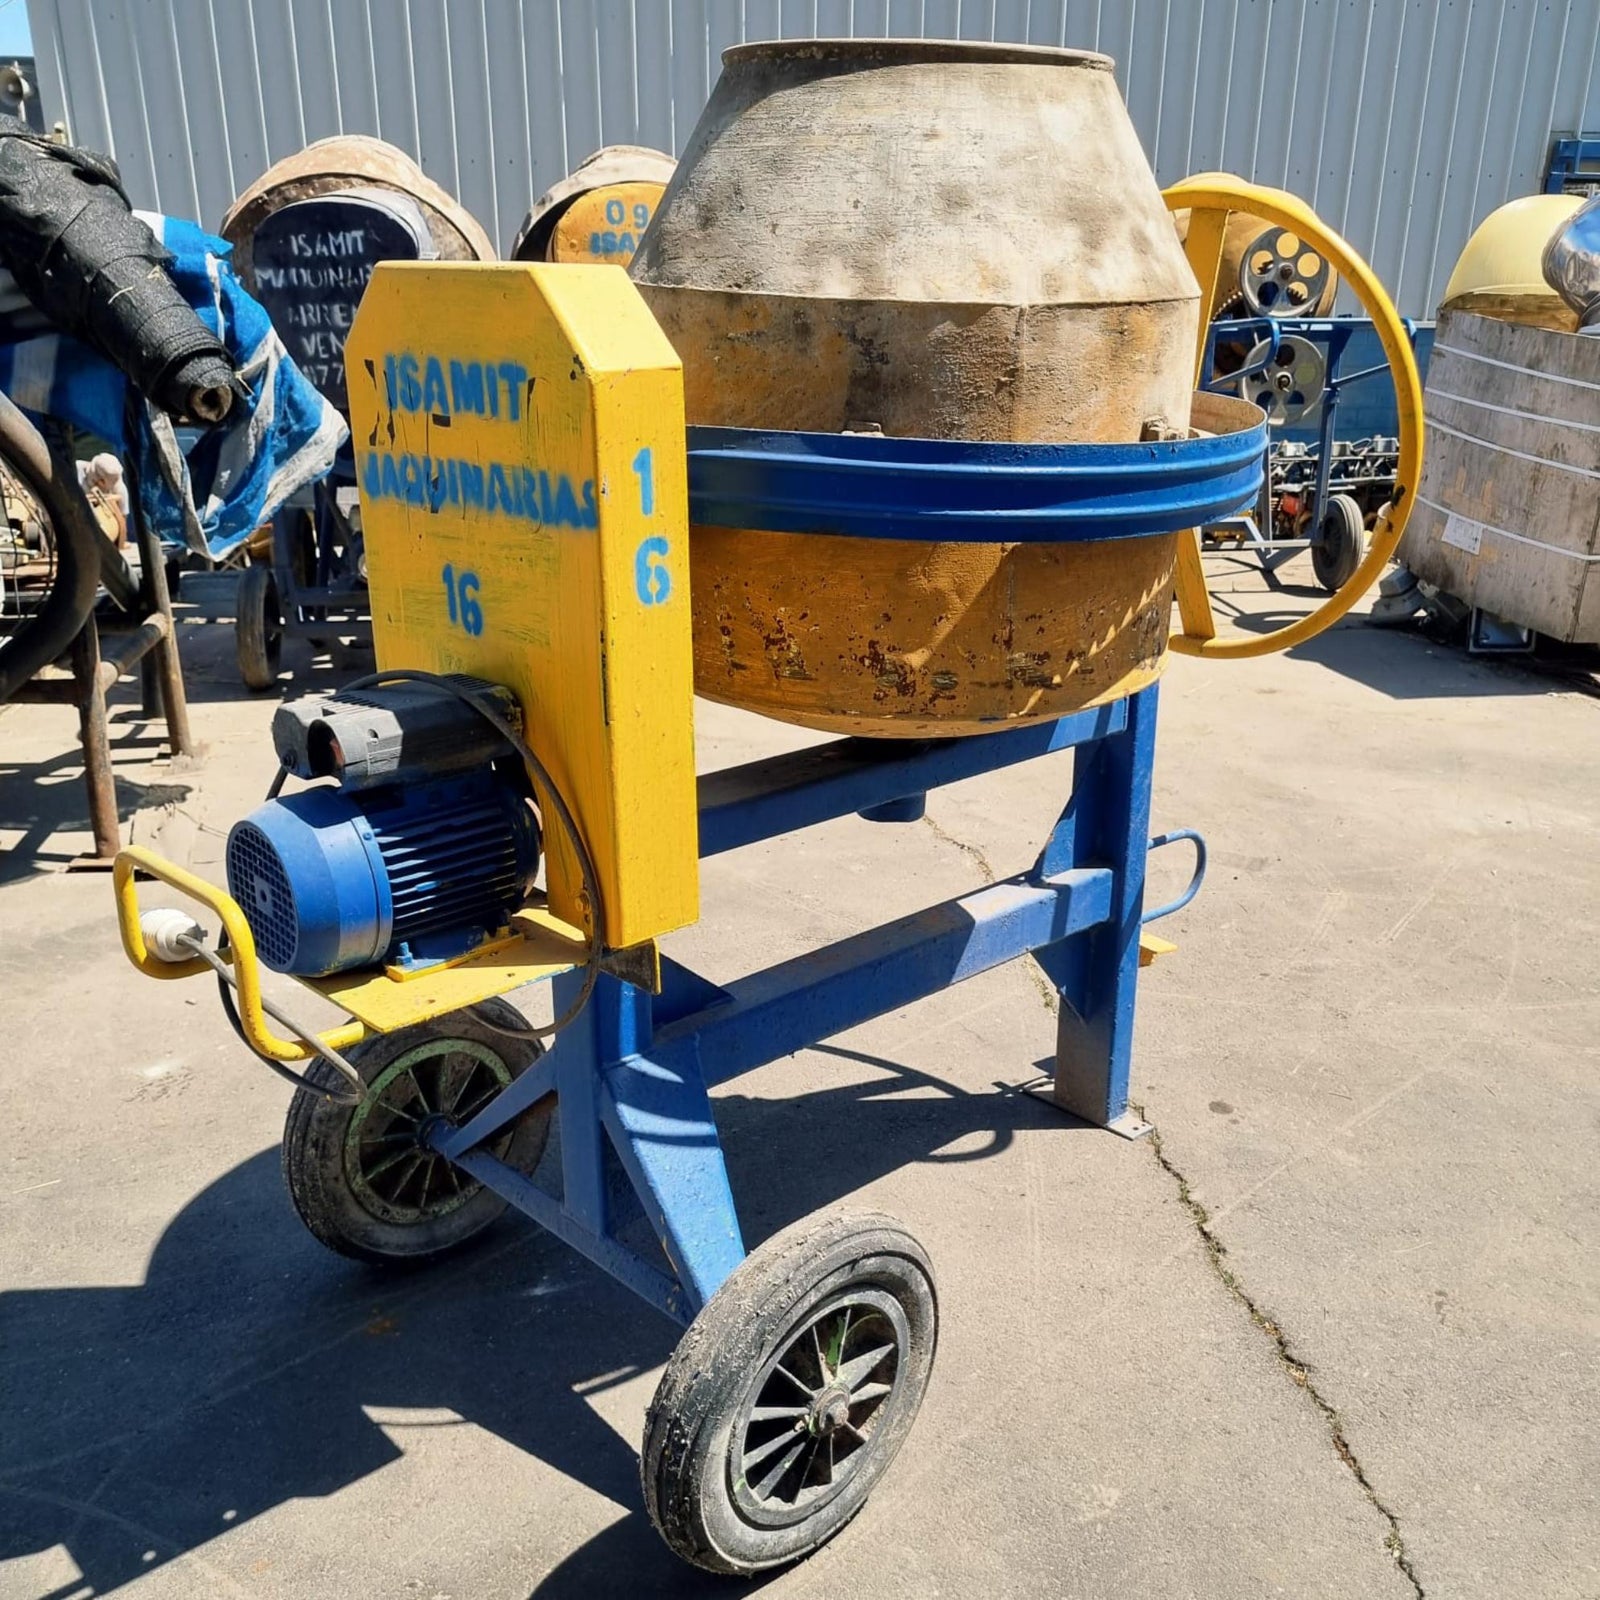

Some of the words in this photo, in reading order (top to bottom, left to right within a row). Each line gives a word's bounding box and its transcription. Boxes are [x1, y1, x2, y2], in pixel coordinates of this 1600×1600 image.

[290, 230, 365, 257] ISAMIT
[590, 231, 644, 255] ISA
[288, 303, 358, 327] ARRE
[385, 352, 529, 421] ISAMIT
[442, 563, 483, 637] 16
